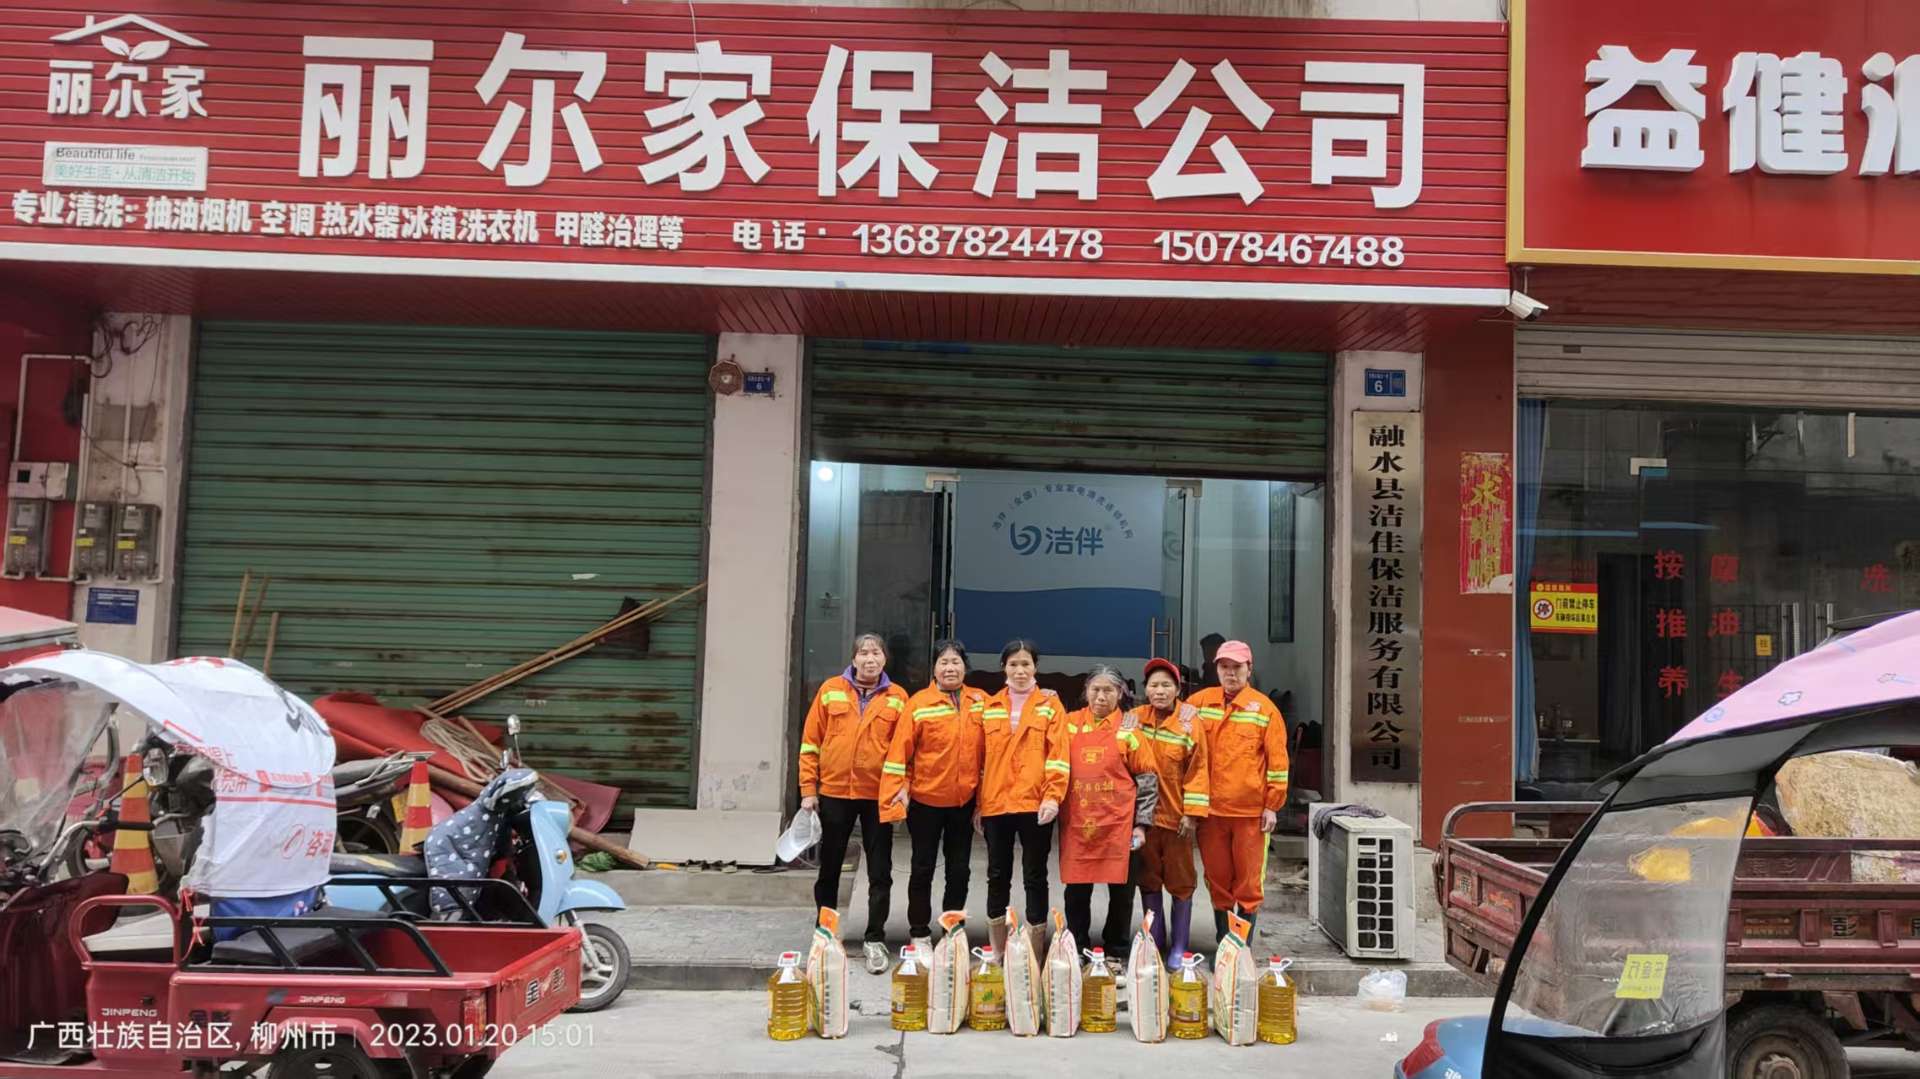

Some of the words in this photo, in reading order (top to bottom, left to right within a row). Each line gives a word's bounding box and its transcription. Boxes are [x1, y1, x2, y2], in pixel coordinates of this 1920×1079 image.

[46, 60, 208, 118] 丽尔家
[297, 32, 1426, 208] 丽尔家保洁公司
[55, 147, 113, 159] Beautiful
[116, 148, 135, 160] life
[555, 211, 684, 250] 甲醛治理等
[852, 223, 1104, 259] 13687824478
[1154, 230, 1405, 267] 15078467488
[1374, 380, 1383, 393] 6
[1045, 526, 1104, 556] 洁伴
[1367, 424, 1405, 770] 融水县洁佳保洁服务有限公司
[101, 1007, 158, 1017] JINPENG
